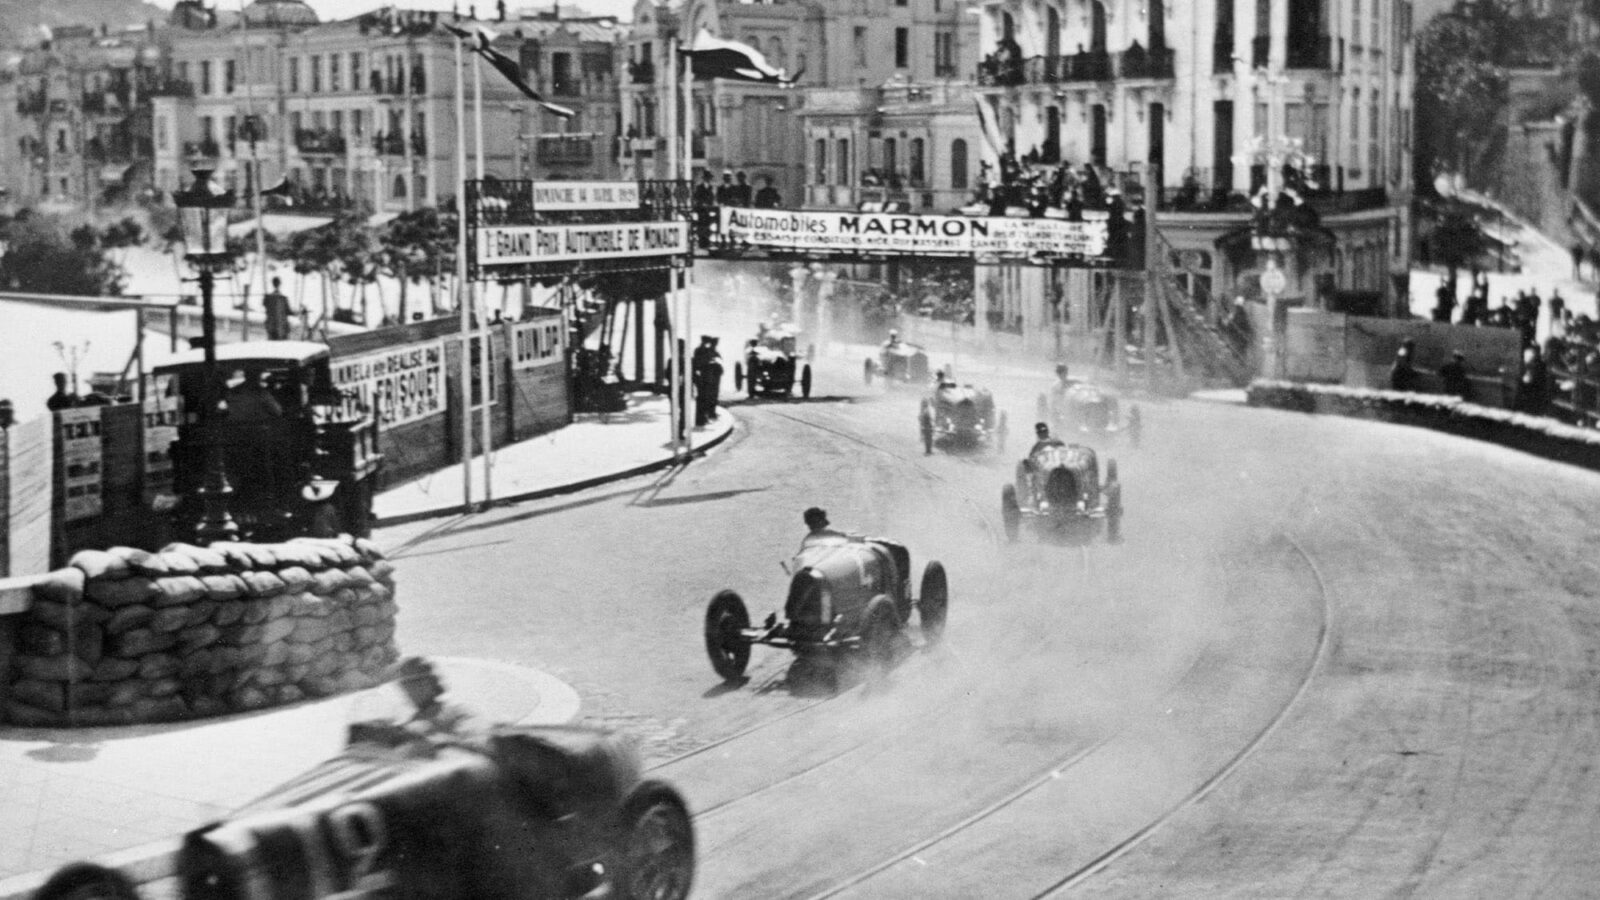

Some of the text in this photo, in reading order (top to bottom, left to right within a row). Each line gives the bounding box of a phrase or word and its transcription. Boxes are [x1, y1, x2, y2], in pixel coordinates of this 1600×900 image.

[728, 209, 988, 238] Automobiles MARMON
[497, 229, 531, 257] GRAND
[537, 228, 560, 256] PRIX
[565, 228, 623, 255] AUTOMOBILE
[628, 228, 639, 252] DE
[644, 226, 679, 251] MONACO
[516, 325, 559, 363] DUNLOP
[377, 366, 439, 410] FRISQUET
